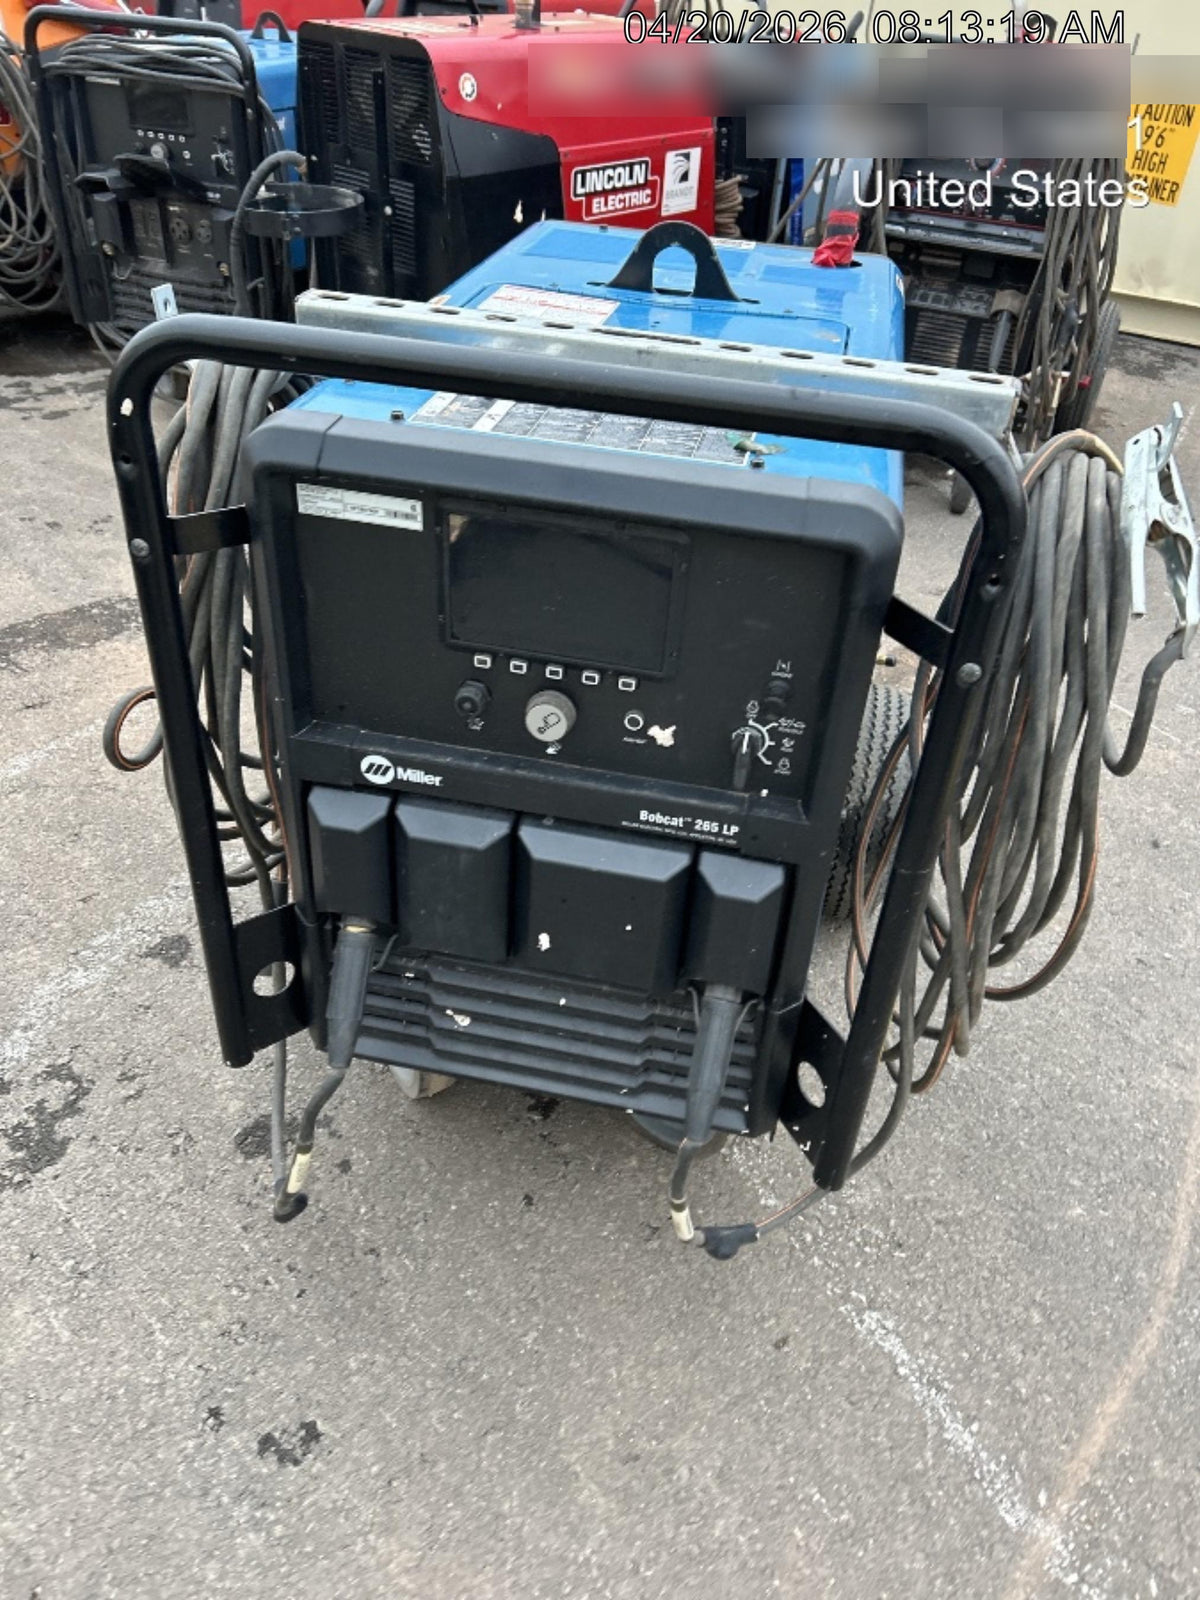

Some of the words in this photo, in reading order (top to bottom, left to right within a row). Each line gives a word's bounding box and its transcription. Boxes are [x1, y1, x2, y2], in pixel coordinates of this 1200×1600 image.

[1131, 149, 1169, 175] HIGH
[576, 163, 646, 195] LINCOLN
[592, 189, 652, 214] ELECTRIC
[396, 766, 443, 787] Miller
[694, 819, 719, 833] 265
[722, 823, 739, 836] LP
